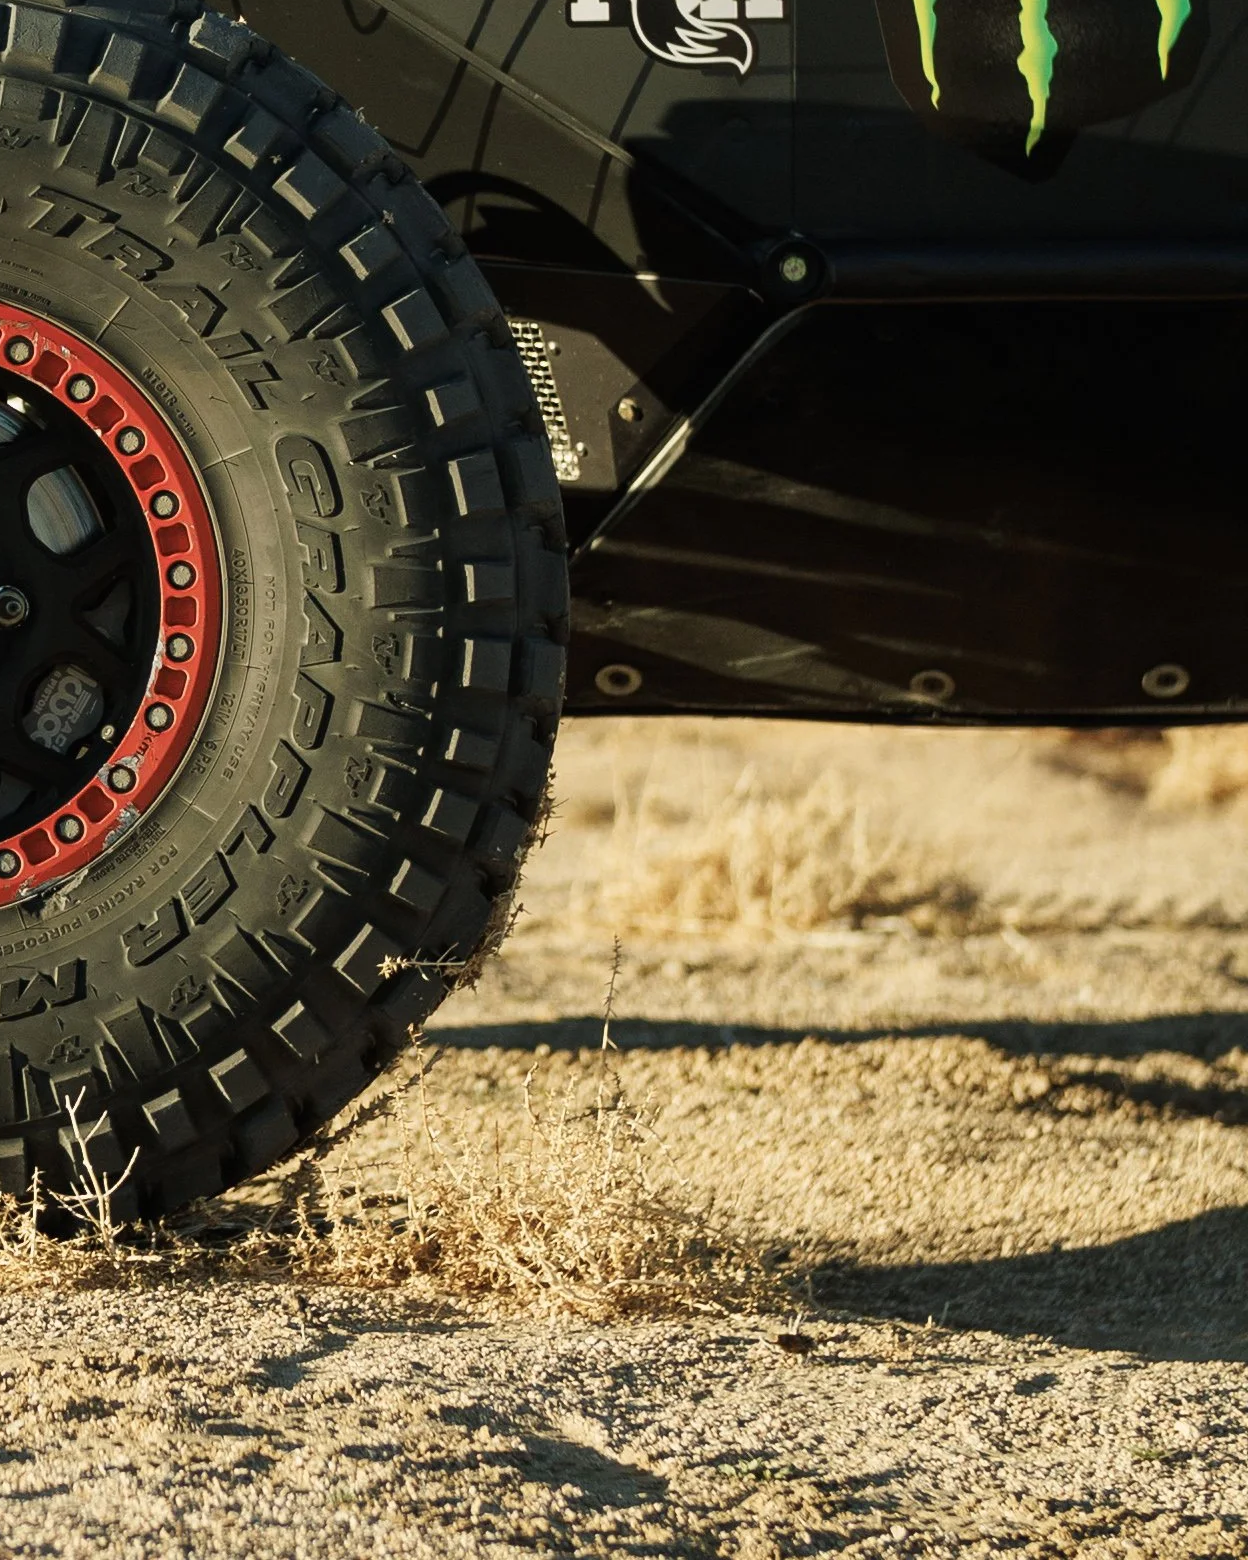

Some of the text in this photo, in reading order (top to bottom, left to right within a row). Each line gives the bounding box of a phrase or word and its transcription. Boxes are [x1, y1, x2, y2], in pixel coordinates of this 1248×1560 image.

[27, 185, 283, 411] TRAIL
[262, 618, 276, 657] FOR
[33, 678, 59, 716] PISTON
[122, 433, 344, 968] GRAPPLER
[242, 662, 271, 742] HIGHWAY
[221, 741, 246, 782] USE
[147, 843, 179, 876] FOR
[87, 875, 147, 920] RACING
